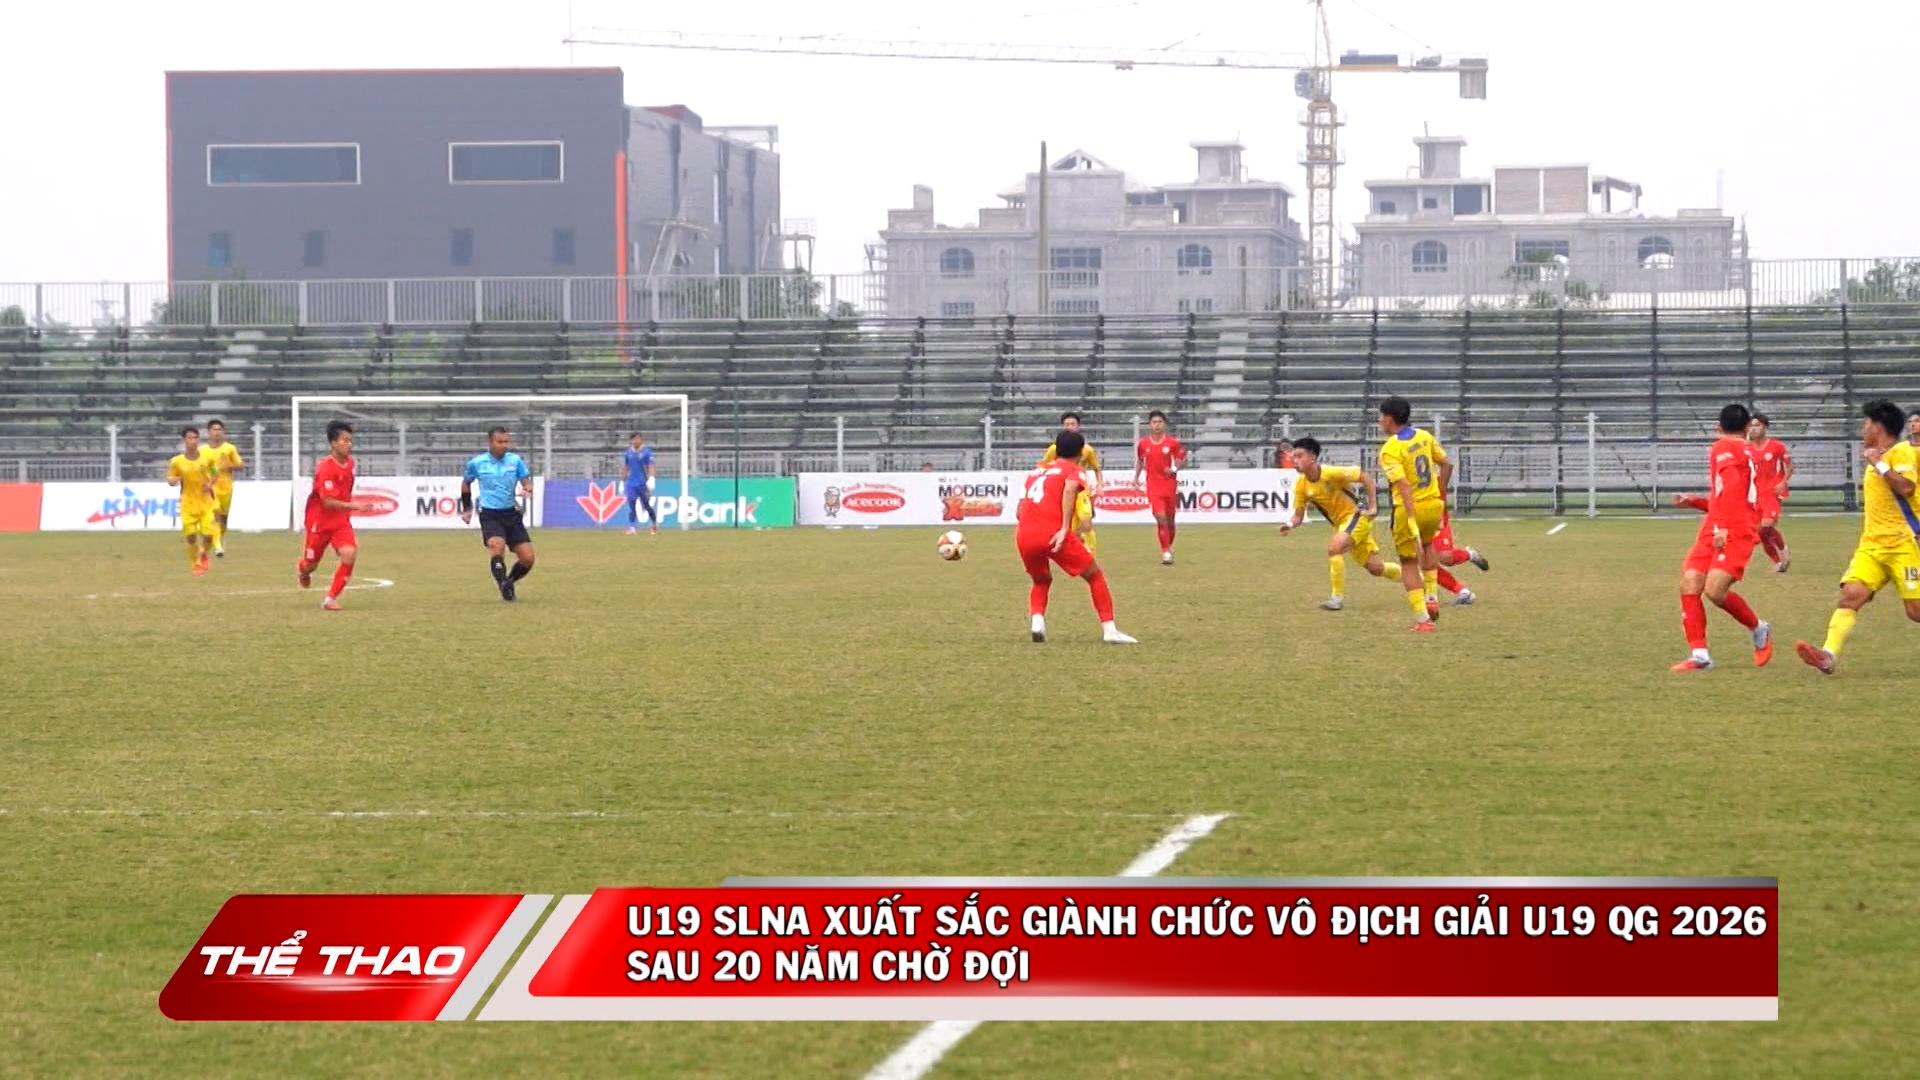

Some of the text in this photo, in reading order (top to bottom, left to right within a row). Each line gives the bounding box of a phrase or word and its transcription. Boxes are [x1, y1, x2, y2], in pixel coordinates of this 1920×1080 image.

[1415, 454, 1431, 488] 9
[938, 484, 1008, 497] MODERN
[1027, 475, 1047, 503] 4
[1176, 491, 1289, 509] MODERN
[635, 496, 763, 523] VPBank
